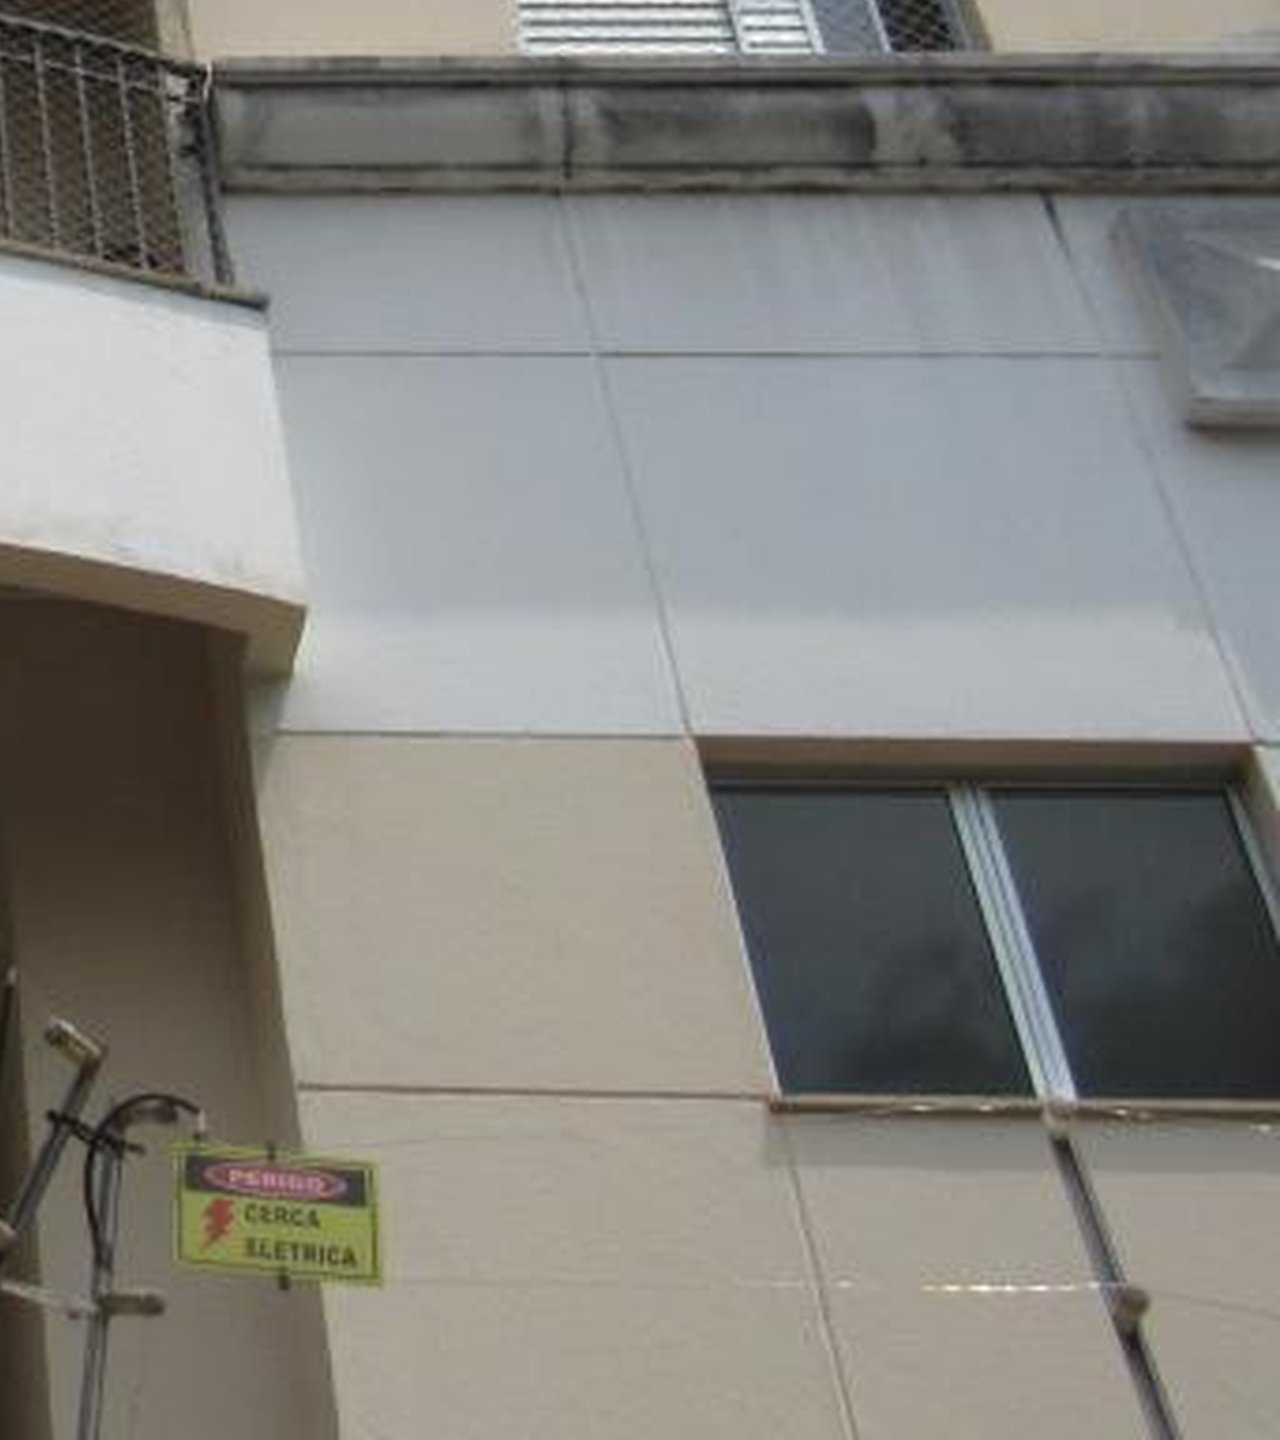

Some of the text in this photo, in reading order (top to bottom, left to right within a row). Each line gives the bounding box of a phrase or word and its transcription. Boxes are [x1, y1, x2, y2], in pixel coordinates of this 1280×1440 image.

[228, 1168, 325, 1193] PERIGO
[244, 1203, 321, 1228] CERCA
[246, 1239, 356, 1266] ELETRICA
